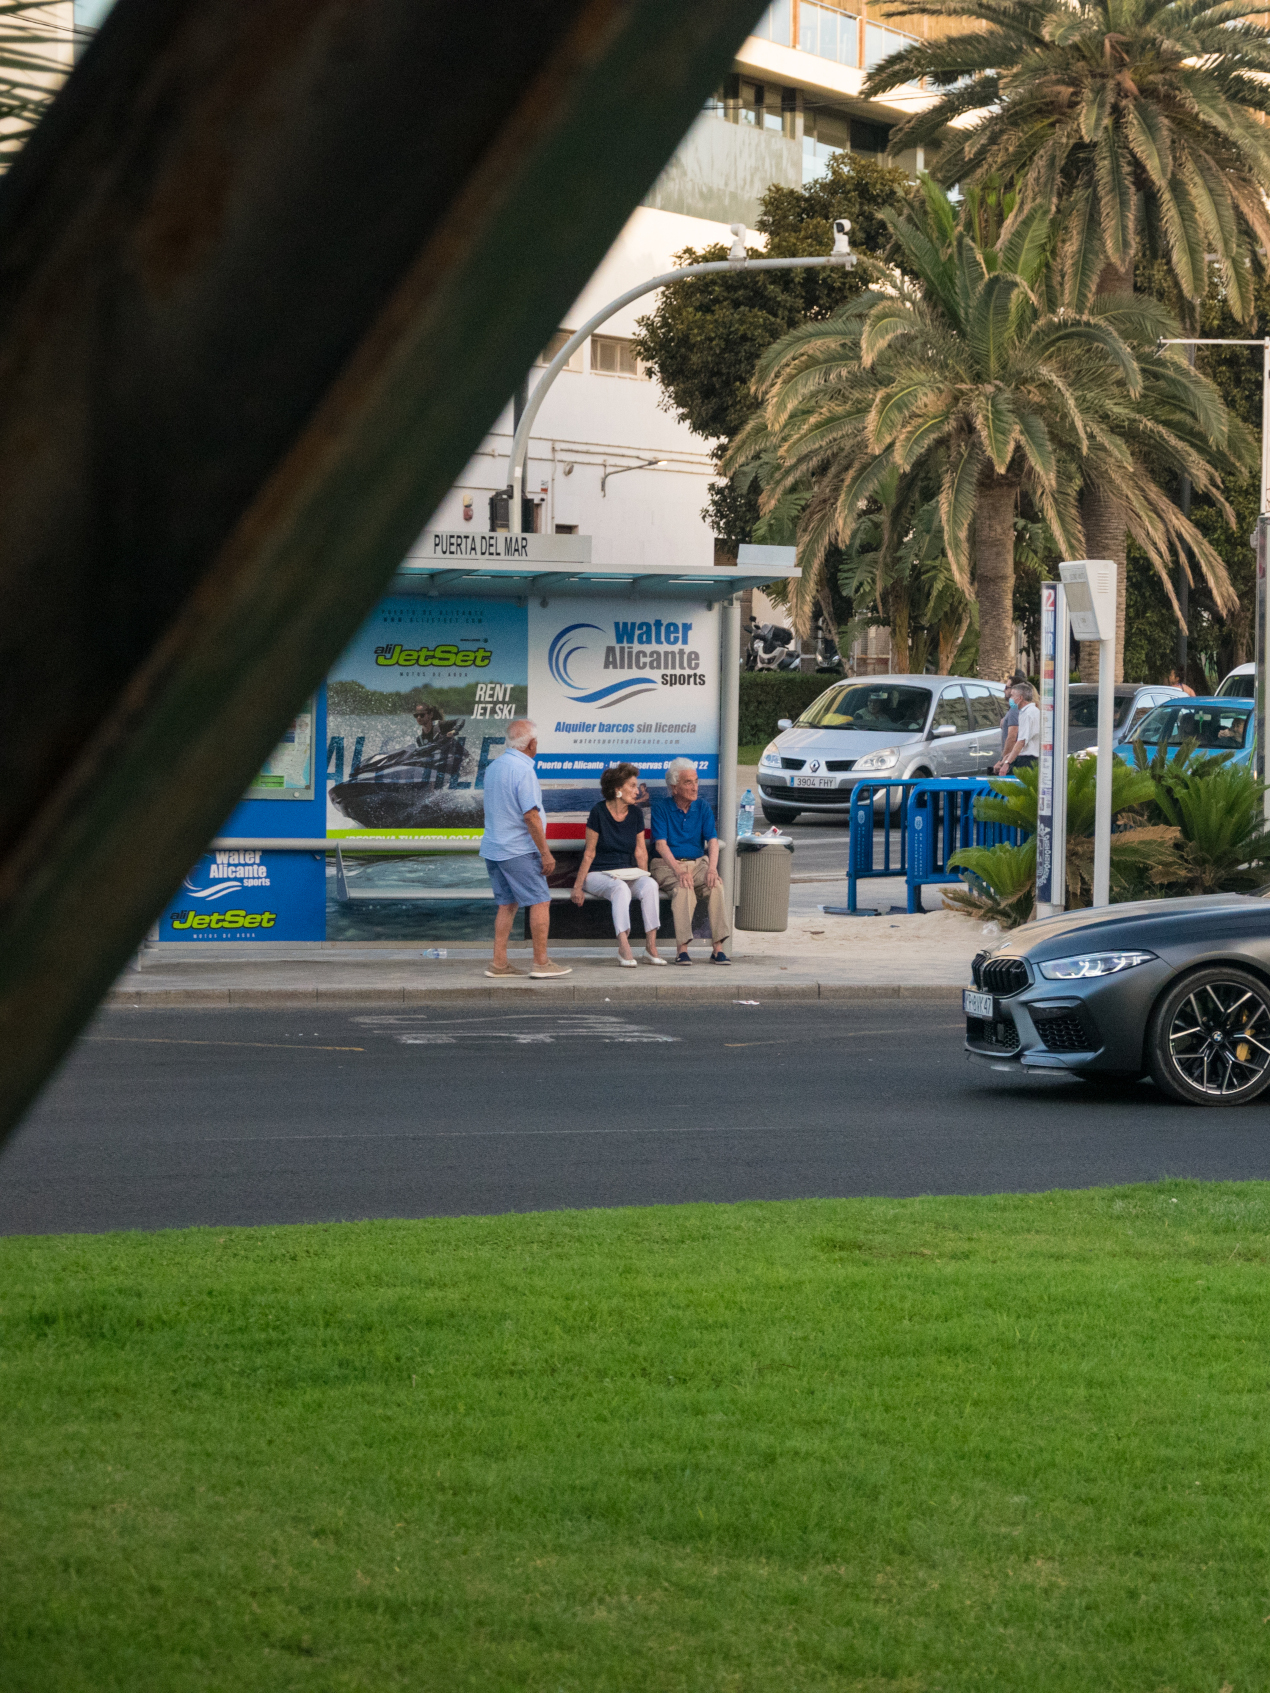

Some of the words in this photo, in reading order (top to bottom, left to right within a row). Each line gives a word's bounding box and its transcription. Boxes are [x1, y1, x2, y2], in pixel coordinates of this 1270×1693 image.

[434, 534, 477, 555] PUERTA
[480, 535, 501, 556] DEL
[504, 536, 528, 557] MAR
[613, 619, 693, 646] water
[603, 645, 700, 671] Alicante
[661, 672, 706, 687] sports
[475, 684, 514, 702] RENT
[471, 704, 494, 719] JET
[494, 704, 515, 719] SKI
[554, 721, 597, 734] Alquiler
[598, 721, 634, 733] barcos
[637, 722, 653, 733] sin
[654, 722, 697, 734] licencia
[537, 761, 562, 769] Puerto
[562, 761, 573, 769] de
[573, 761, 604, 769] Alicante
[698, 761, 709, 770] 22
[797, 777, 816, 787] 3904
[818, 778, 834, 788] FHY
[216, 850, 263, 865] water
[209, 864, 267, 879] Alicante
[243, 877, 271, 887] sports
